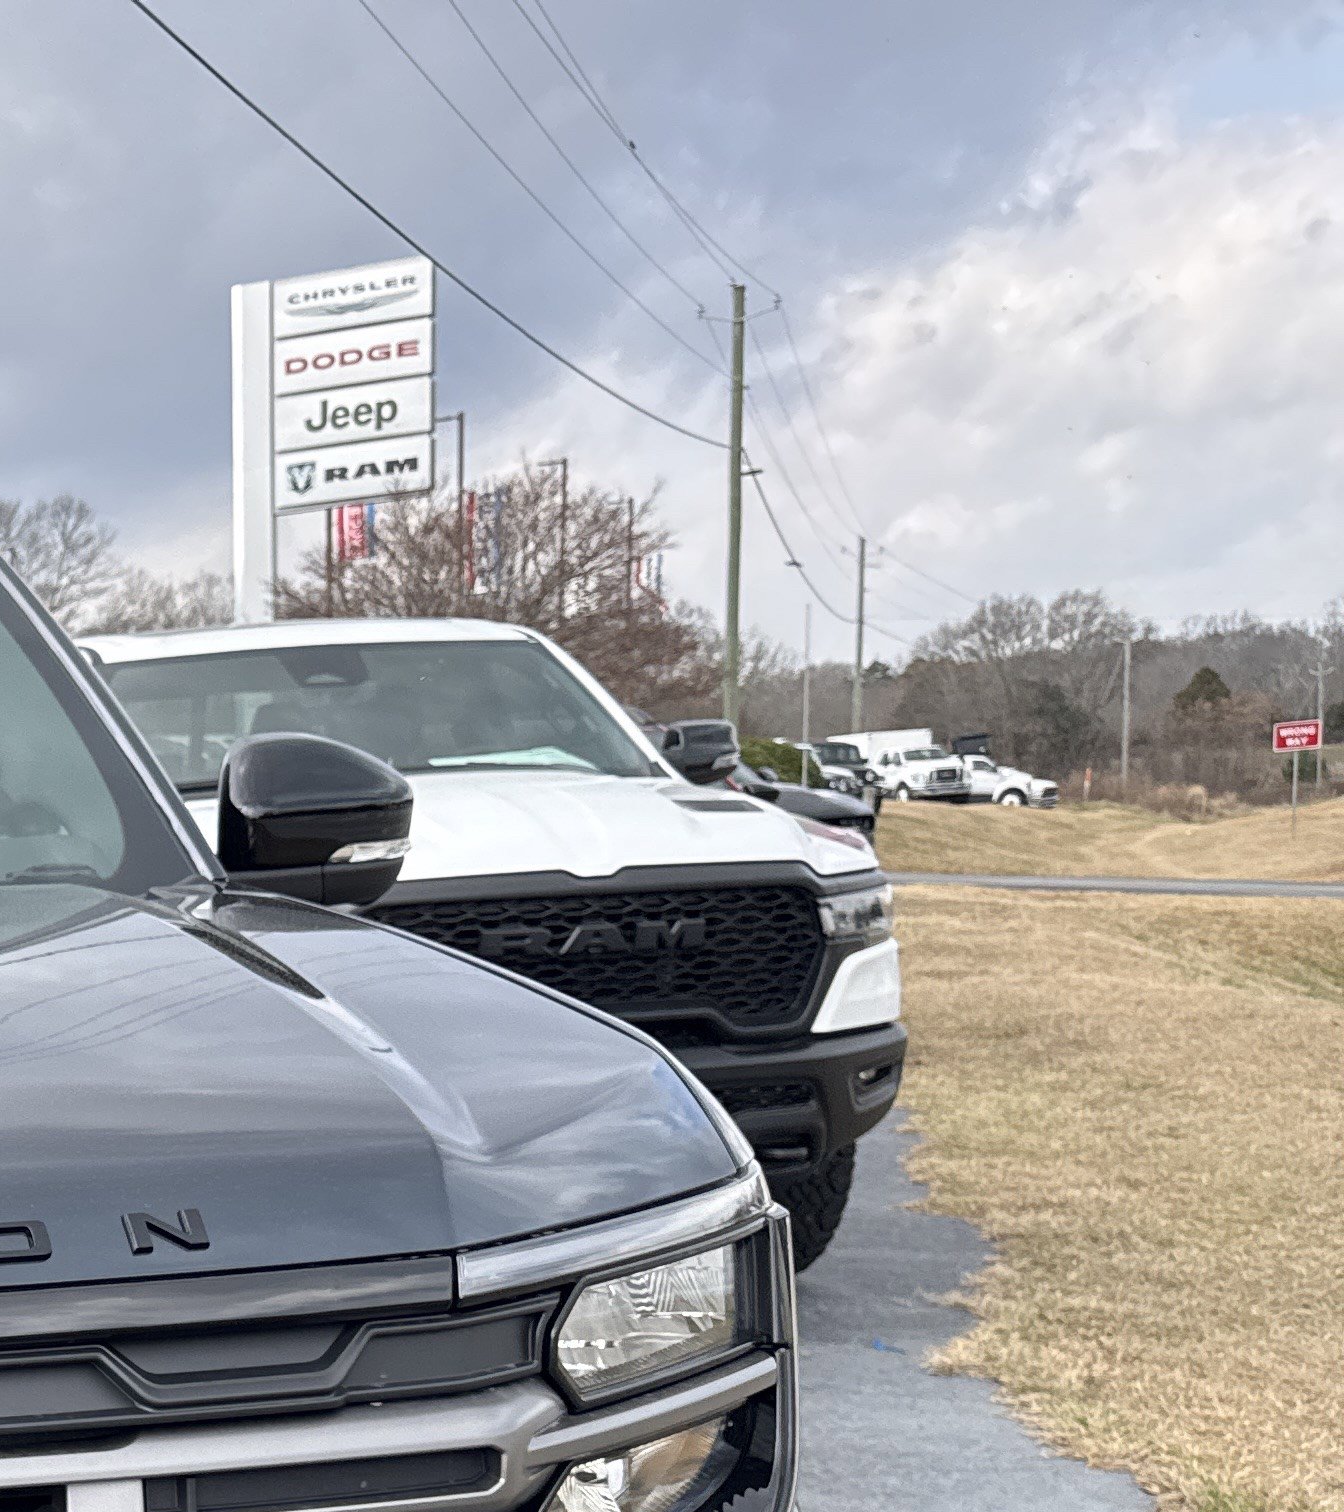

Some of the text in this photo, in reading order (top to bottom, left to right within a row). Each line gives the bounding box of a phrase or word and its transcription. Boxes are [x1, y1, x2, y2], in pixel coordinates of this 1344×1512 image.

[287, 274, 417, 306] CHRYSLER
[283, 339, 421, 375] DODGE
[303, 397, 398, 433] Jeep
[324, 456, 419, 484] RAM
[478, 918, 707, 955] RAM
